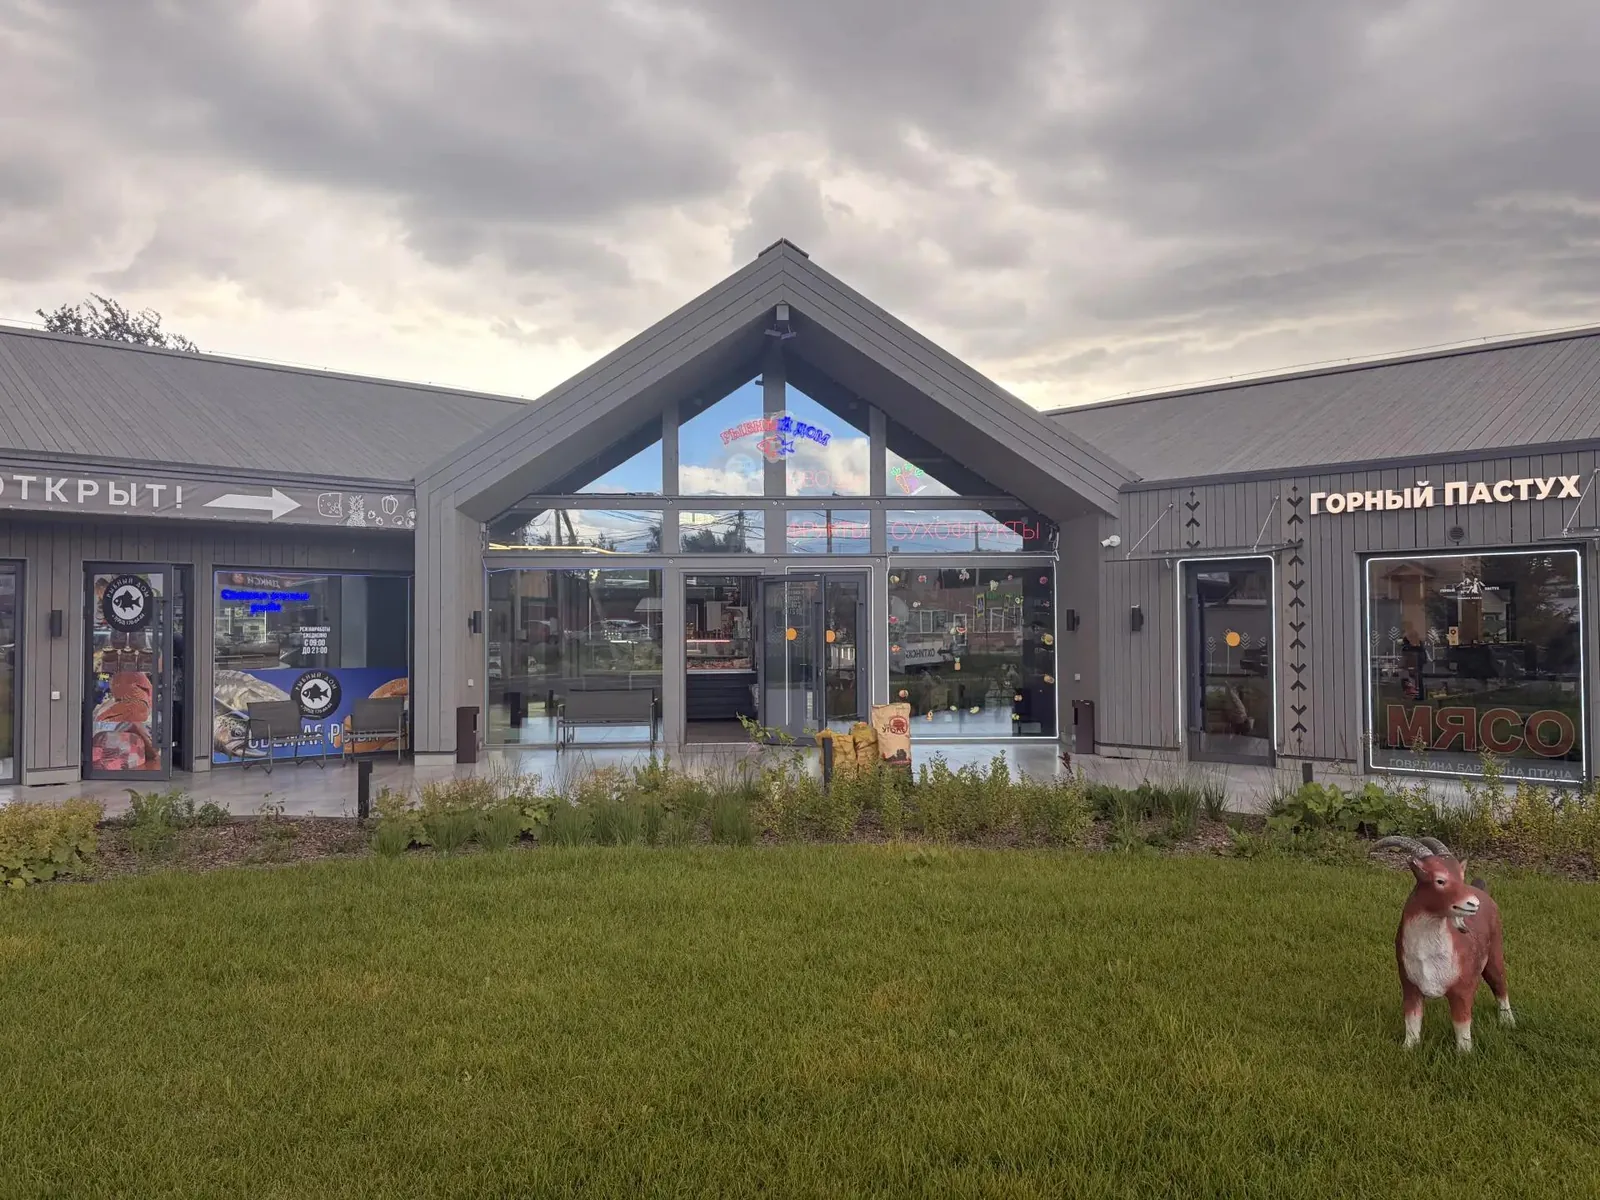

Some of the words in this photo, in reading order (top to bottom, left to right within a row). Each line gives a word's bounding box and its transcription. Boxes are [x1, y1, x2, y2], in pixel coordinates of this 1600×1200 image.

[792, 421, 832, 446] ДОМ
[1310, 480, 1434, 515] ГОРНЫЙ
[1444, 475, 1581, 506] ПАСТУХ
[890, 520, 1041, 540] СУХОФРУКТЫ
[302, 647, 311, 655] ДО
[324, 675, 338, 690] ДОМ
[1387, 704, 1575, 757] МЯСО
